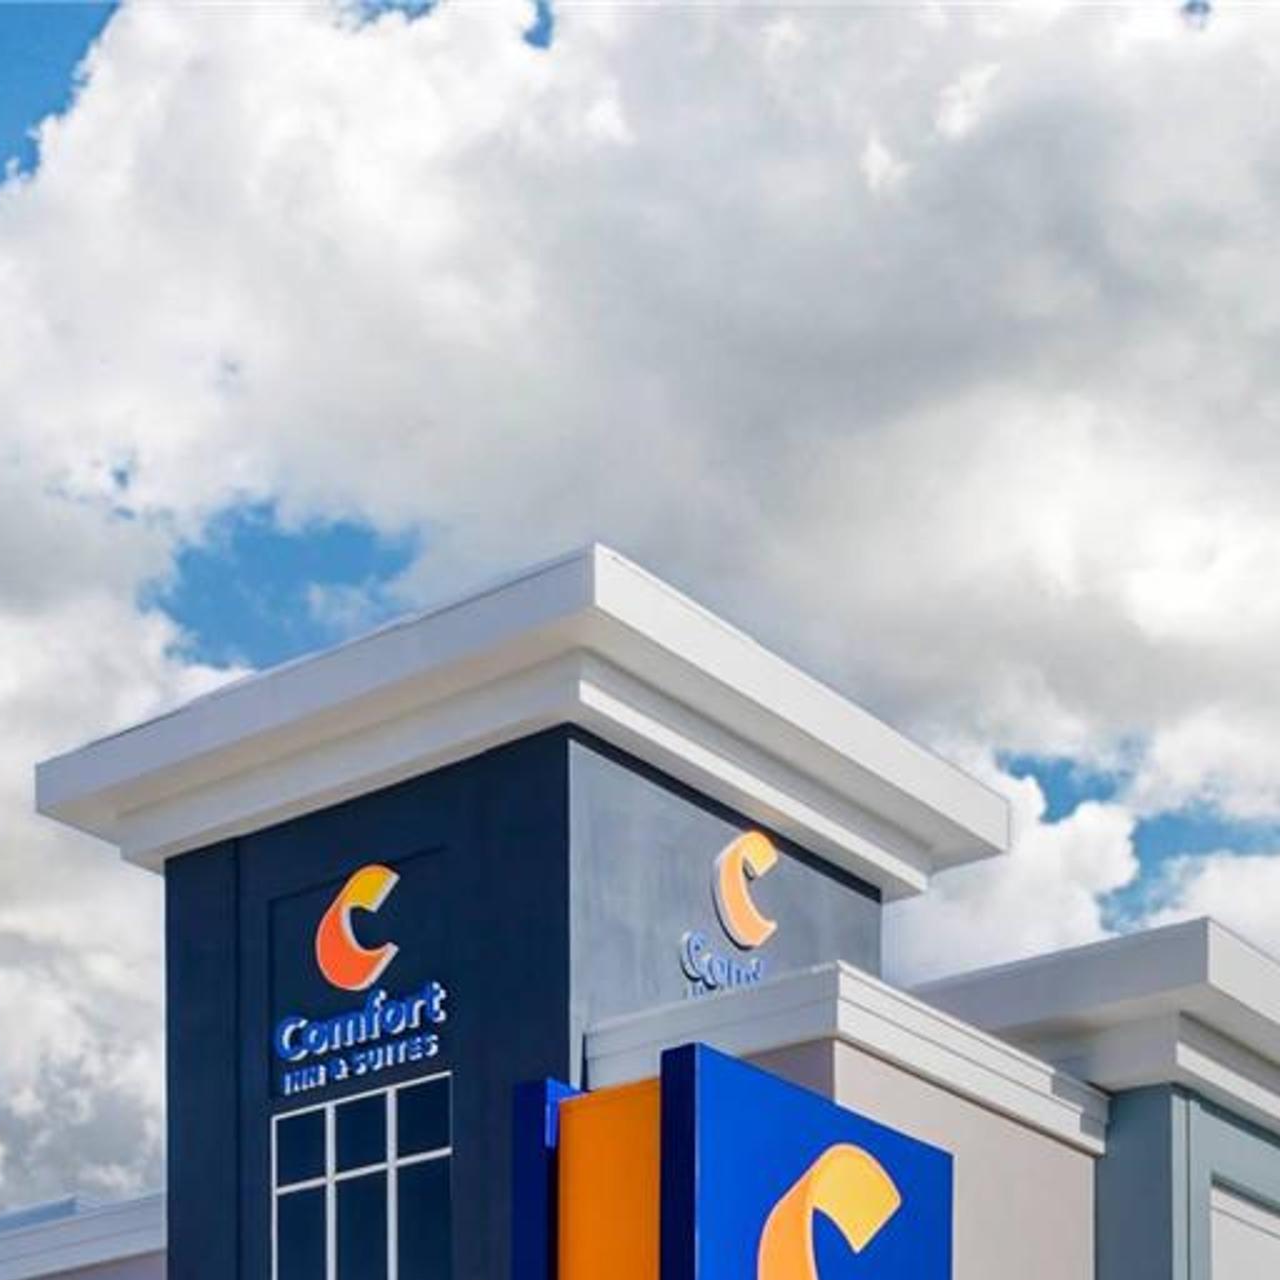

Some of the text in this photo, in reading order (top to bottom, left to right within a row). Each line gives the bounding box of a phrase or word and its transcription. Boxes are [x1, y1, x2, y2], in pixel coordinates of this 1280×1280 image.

[276, 980, 447, 1062] Comfort
[281, 1063, 327, 1096] INN
[353, 1033, 439, 1075] SUITES
